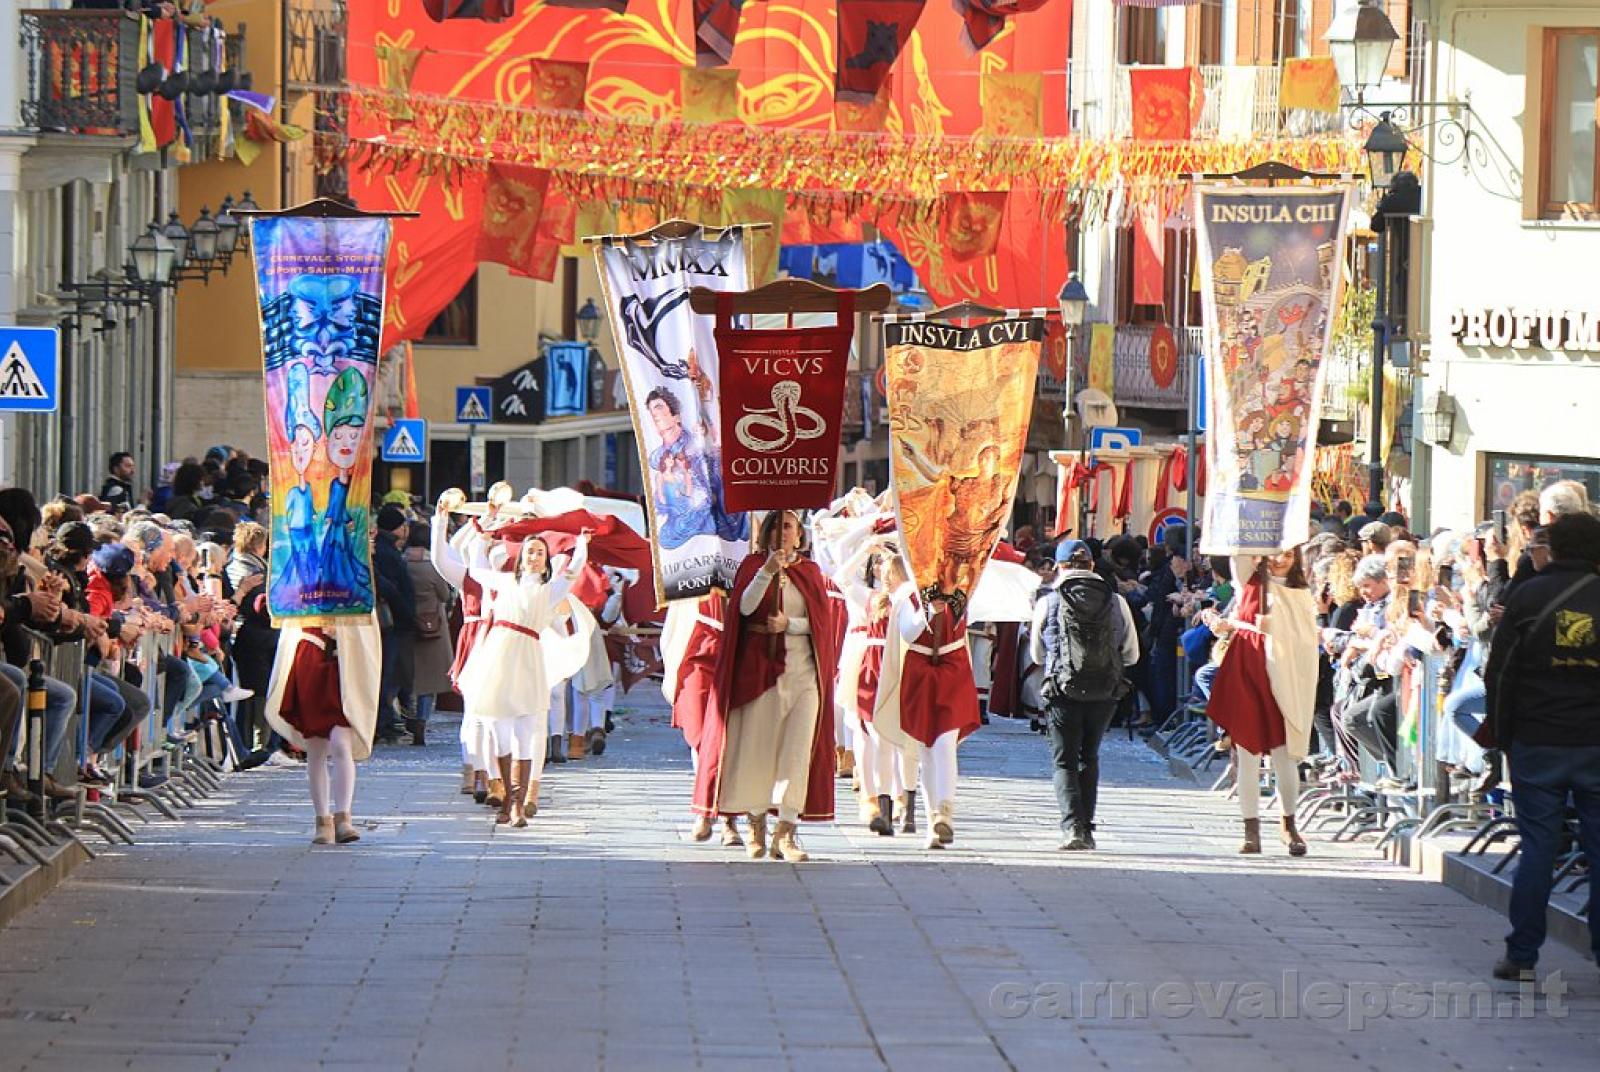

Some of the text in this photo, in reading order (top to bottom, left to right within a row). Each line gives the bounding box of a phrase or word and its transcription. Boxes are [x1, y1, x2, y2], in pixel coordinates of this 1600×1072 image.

[1211, 203, 1337, 223] INSULA CIII
[899, 321, 1030, 350] INSVLA CVI
[742, 357, 824, 376] VICVS
[731, 457, 829, 477] COLVBRIS
